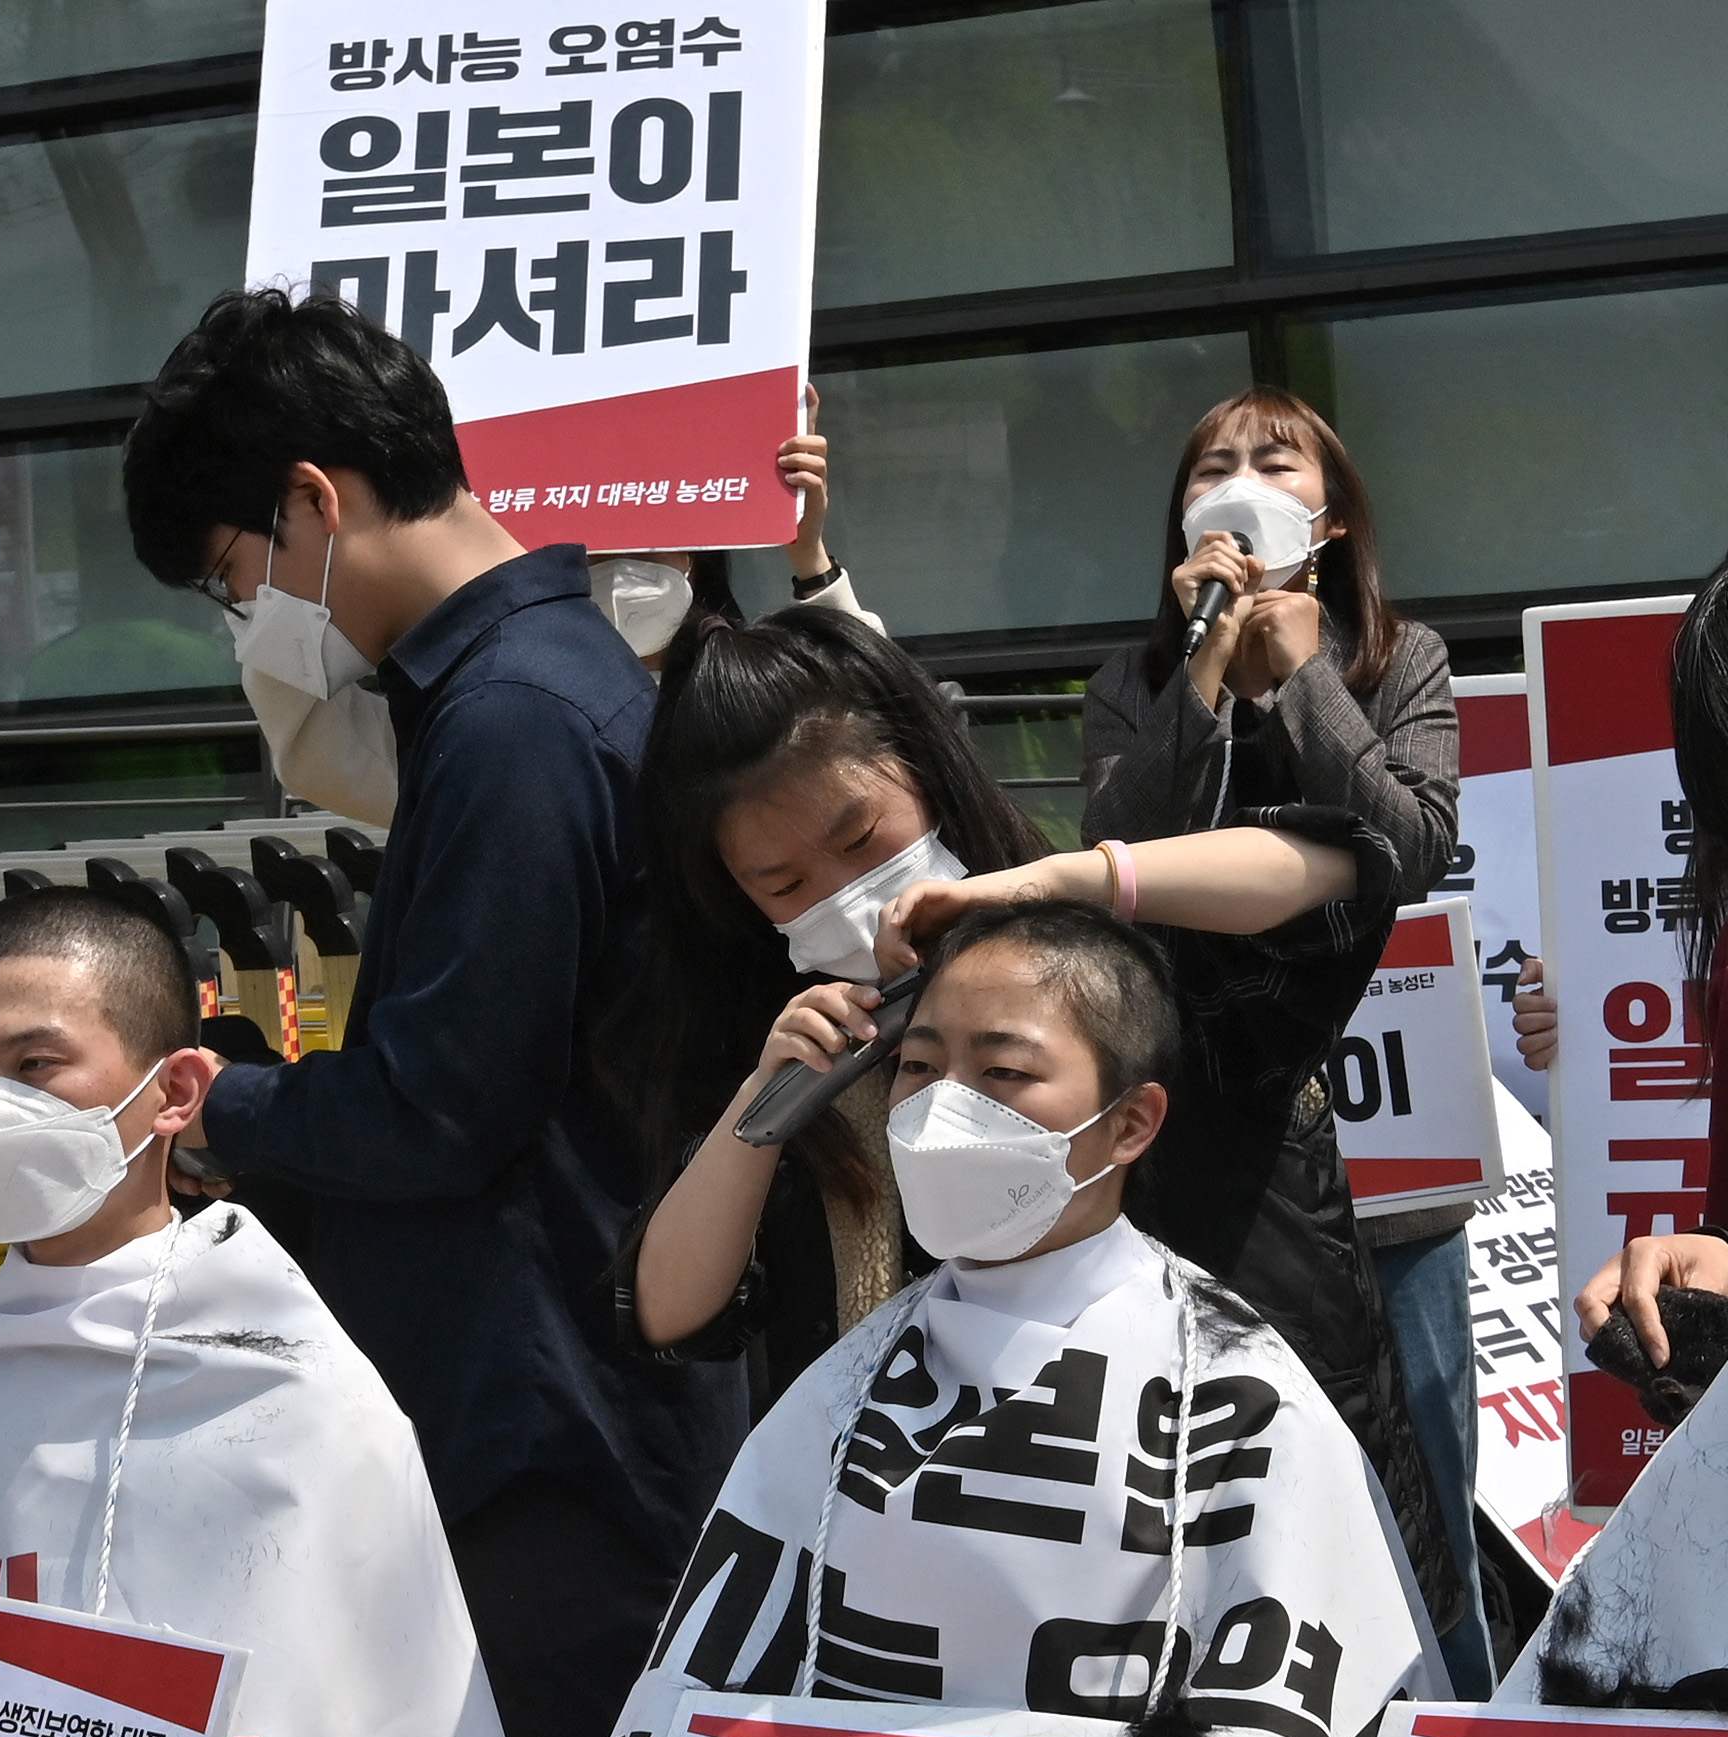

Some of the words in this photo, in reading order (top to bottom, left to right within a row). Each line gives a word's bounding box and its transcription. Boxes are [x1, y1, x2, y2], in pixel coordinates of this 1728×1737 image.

[328, 32, 522, 91] 방사능
[545, 16, 743, 77] 오염수
[318, 91, 743, 228] 일본이
[310, 230, 748, 362] 마셔라
[488, 485, 537, 513] 방류
[542, 483, 590, 508] 저지
[596, 480, 670, 507] 대학생
[675, 477, 750, 504] 농성단
[1388, 971, 1436, 995] 농성단
[1621, 1428, 1665, 1456] 일본
